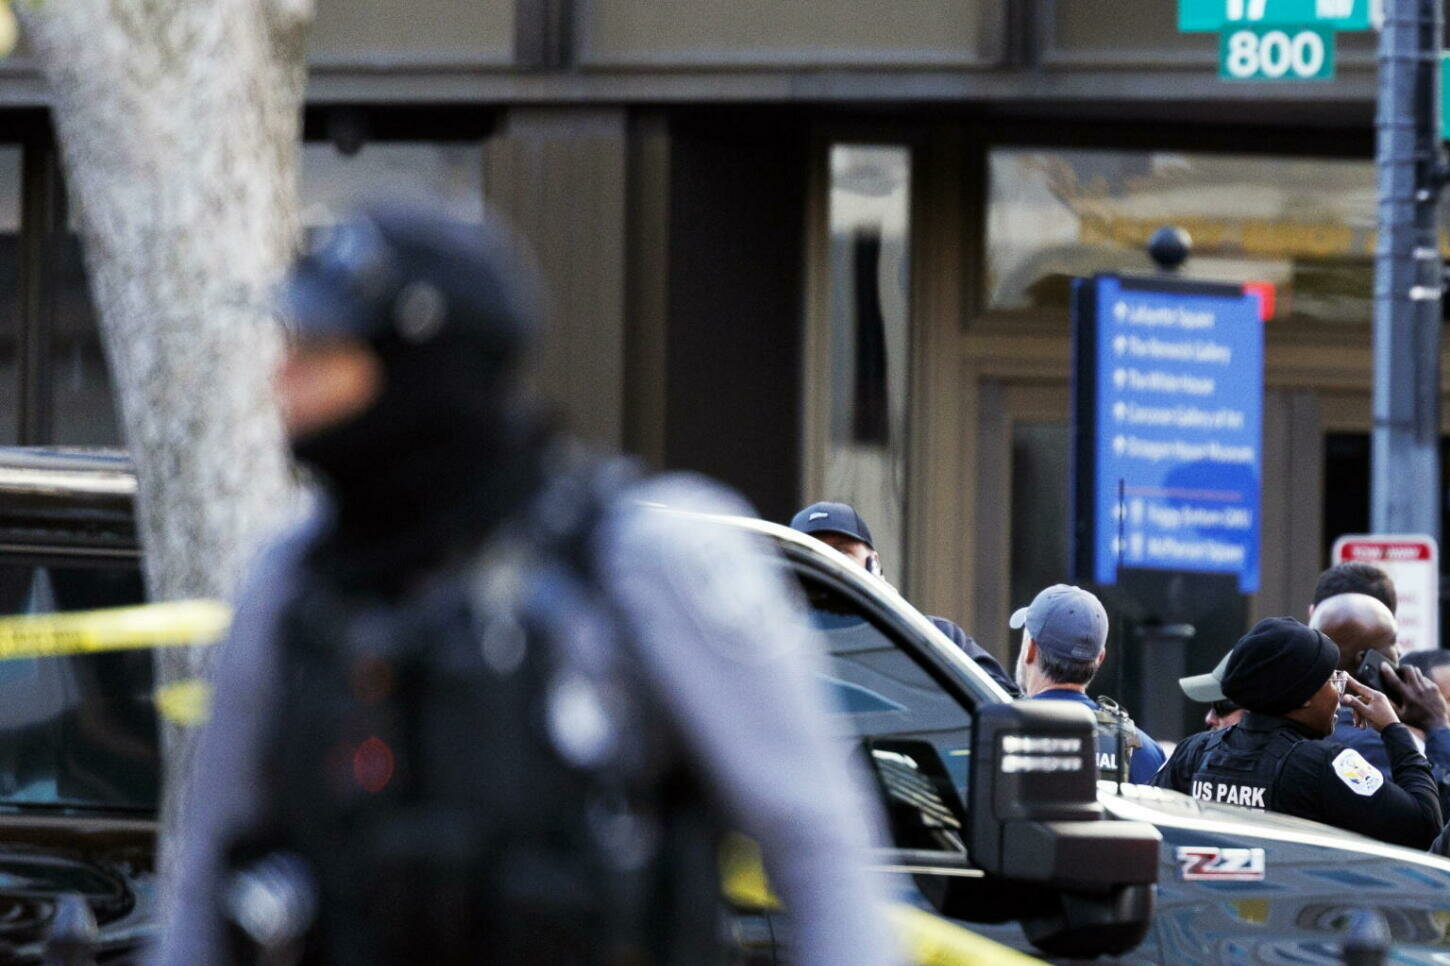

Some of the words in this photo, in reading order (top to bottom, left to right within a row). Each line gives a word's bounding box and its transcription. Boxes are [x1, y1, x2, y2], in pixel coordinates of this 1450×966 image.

[1226, 30, 1325, 78] 800
[1192, 780, 1213, 800] US
[1216, 782, 1267, 808] PARK
